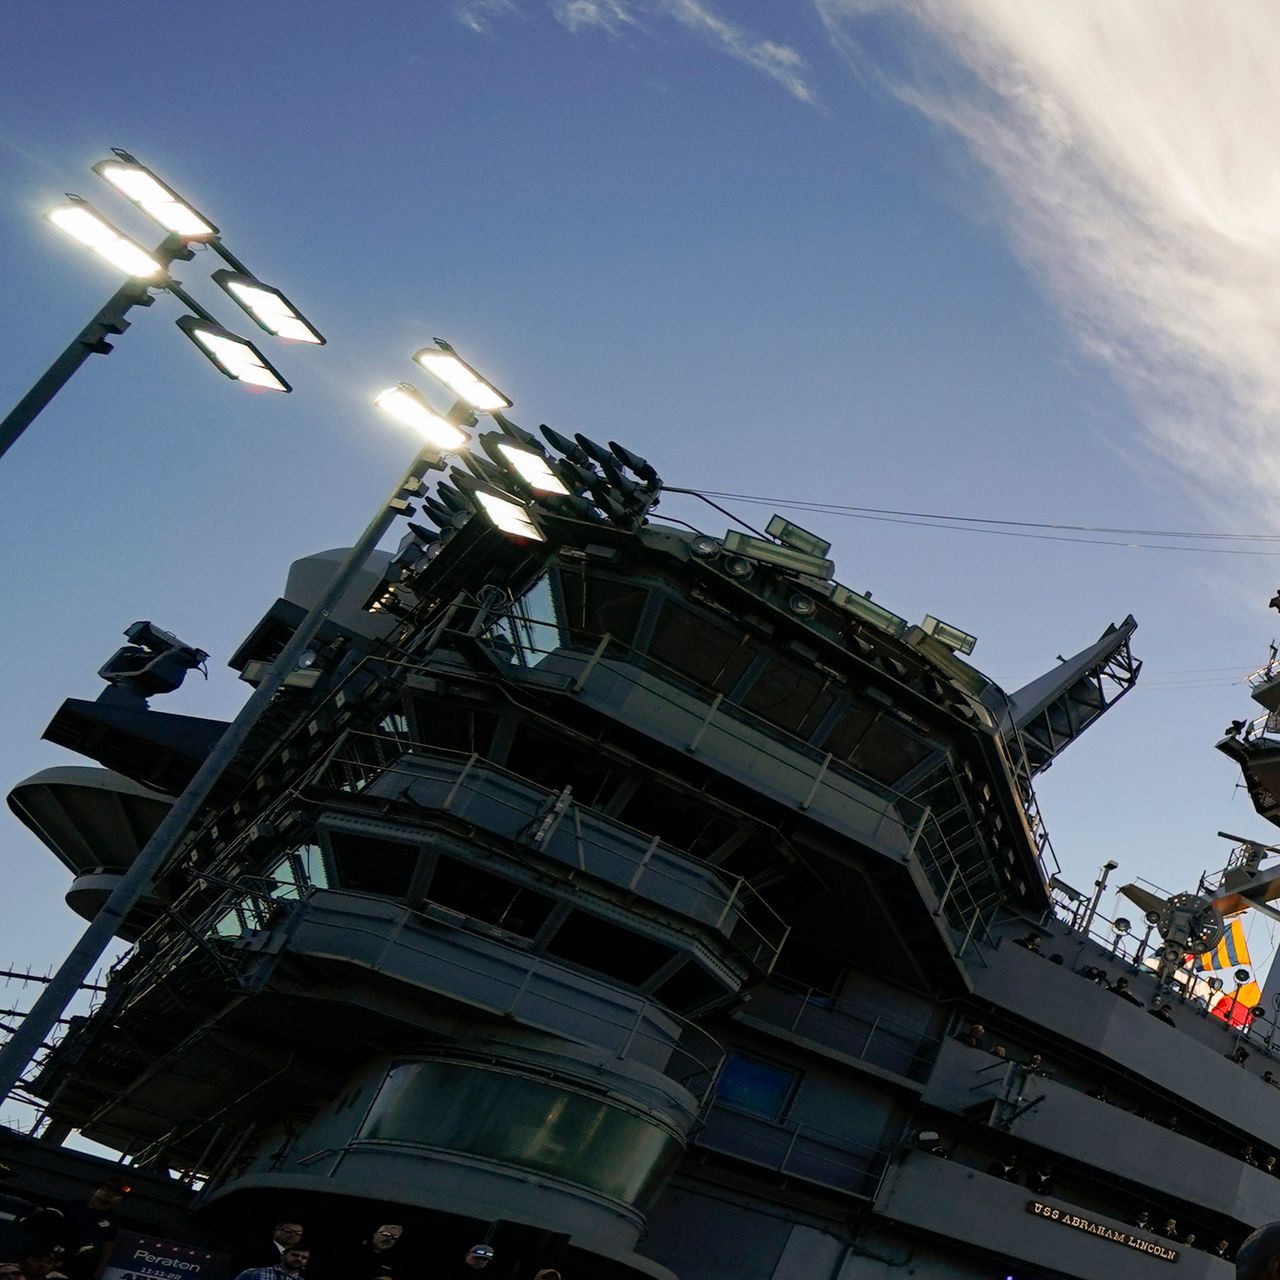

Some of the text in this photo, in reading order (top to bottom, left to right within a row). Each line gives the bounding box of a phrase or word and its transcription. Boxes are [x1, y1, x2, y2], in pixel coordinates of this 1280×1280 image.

[1034, 1202, 1176, 1260] USS ABRAHAM LINCOLN
[133, 1249, 200, 1272] Peraton
